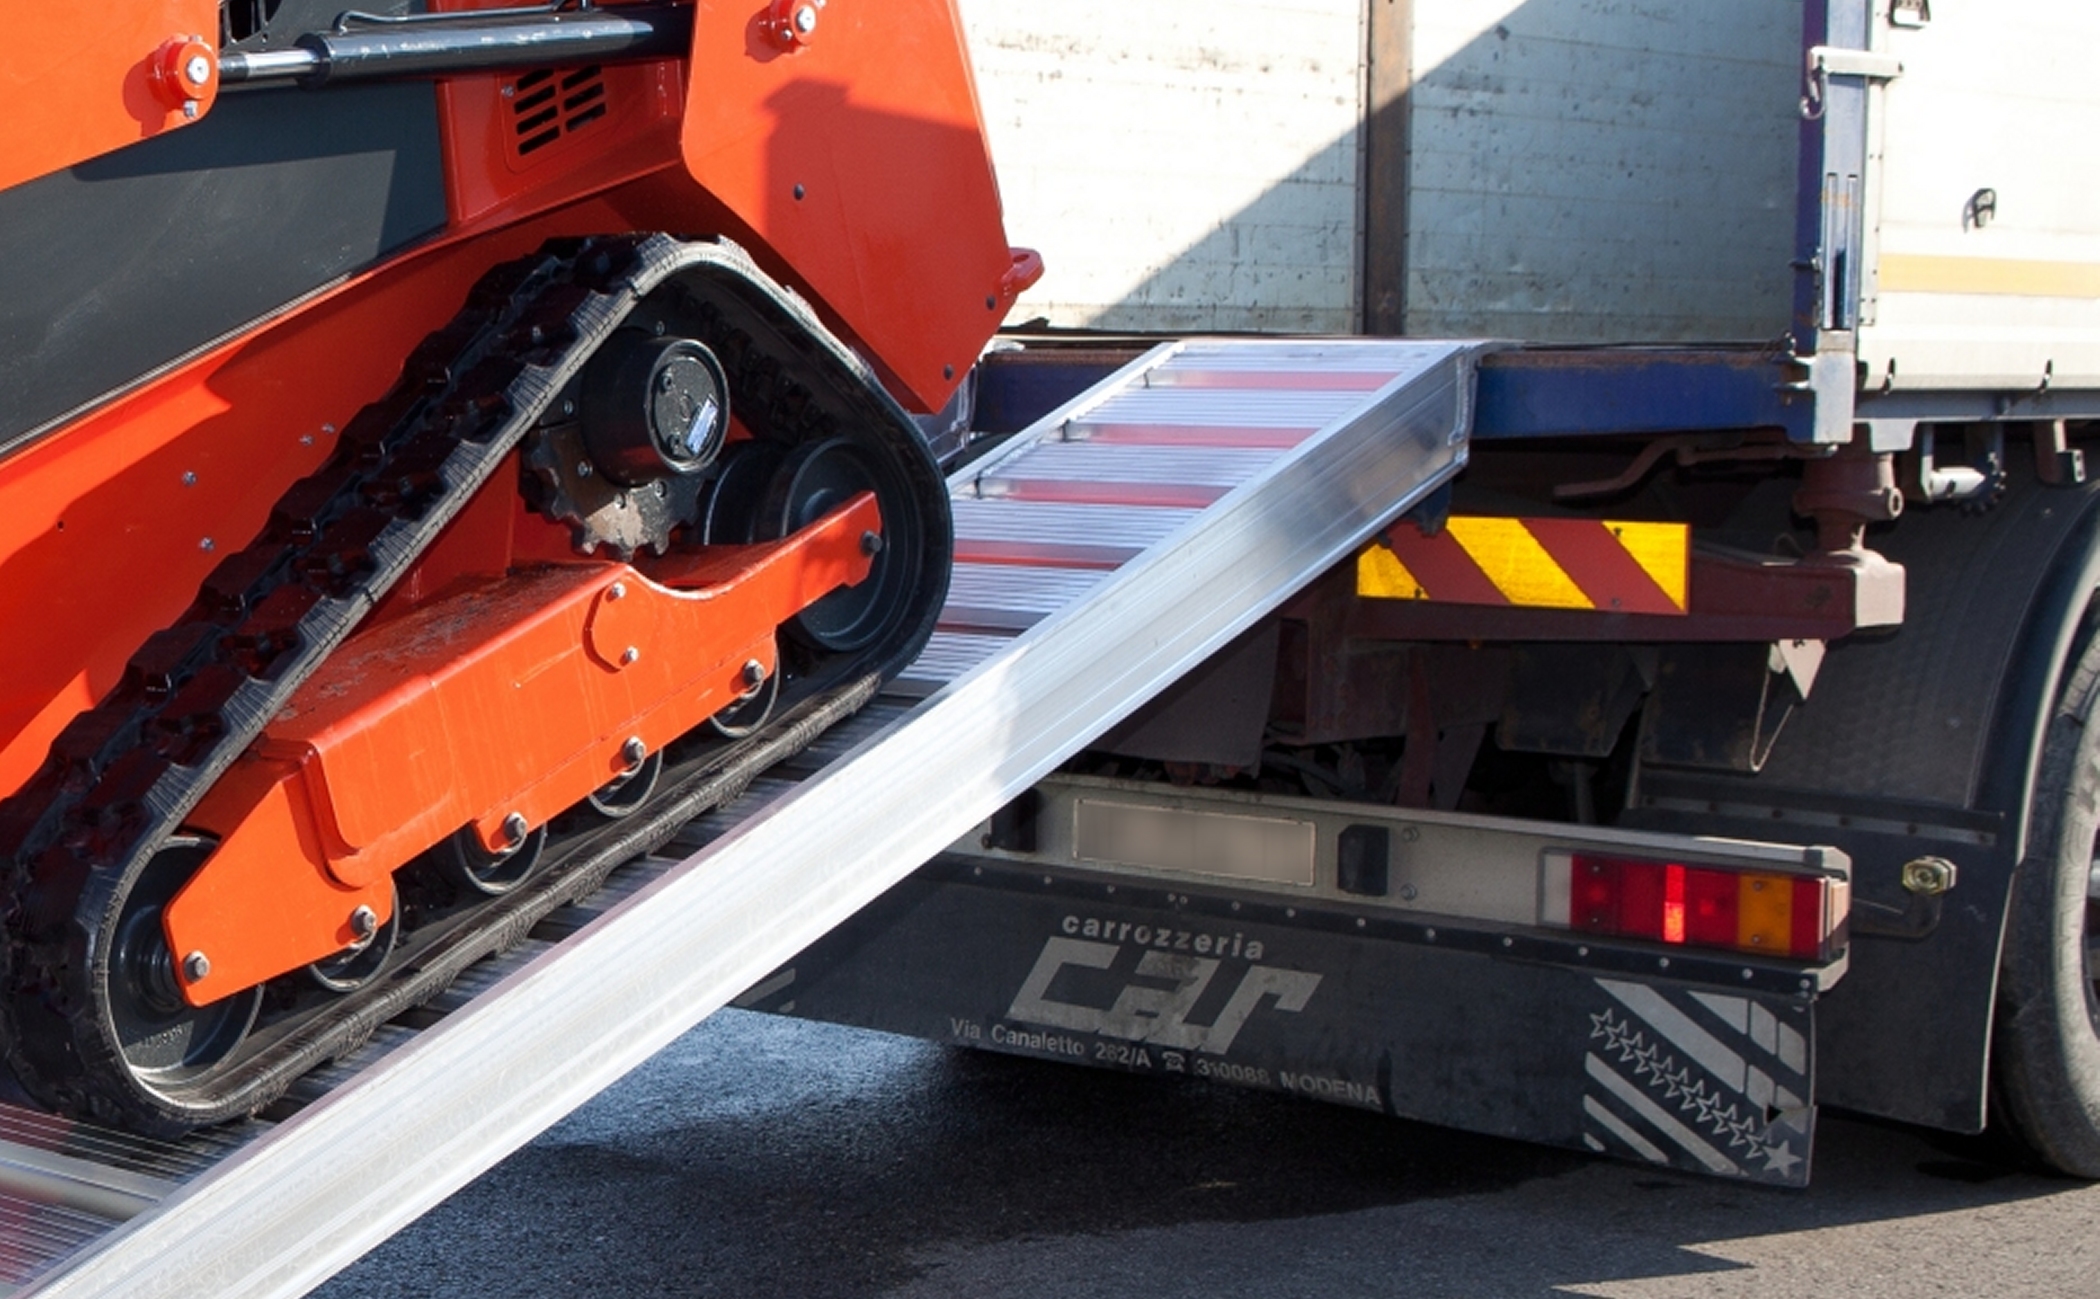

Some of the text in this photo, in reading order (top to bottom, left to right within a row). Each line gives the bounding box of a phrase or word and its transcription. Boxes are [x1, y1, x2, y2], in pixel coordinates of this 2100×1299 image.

[1061, 914, 1265, 961] carrozzeria
[951, 1017, 981, 1040] Via
[991, 1023, 1085, 1056] Canaletto
[1095, 1041, 1152, 1069] 262/A
[1279, 1070, 1381, 1105] MODENA
